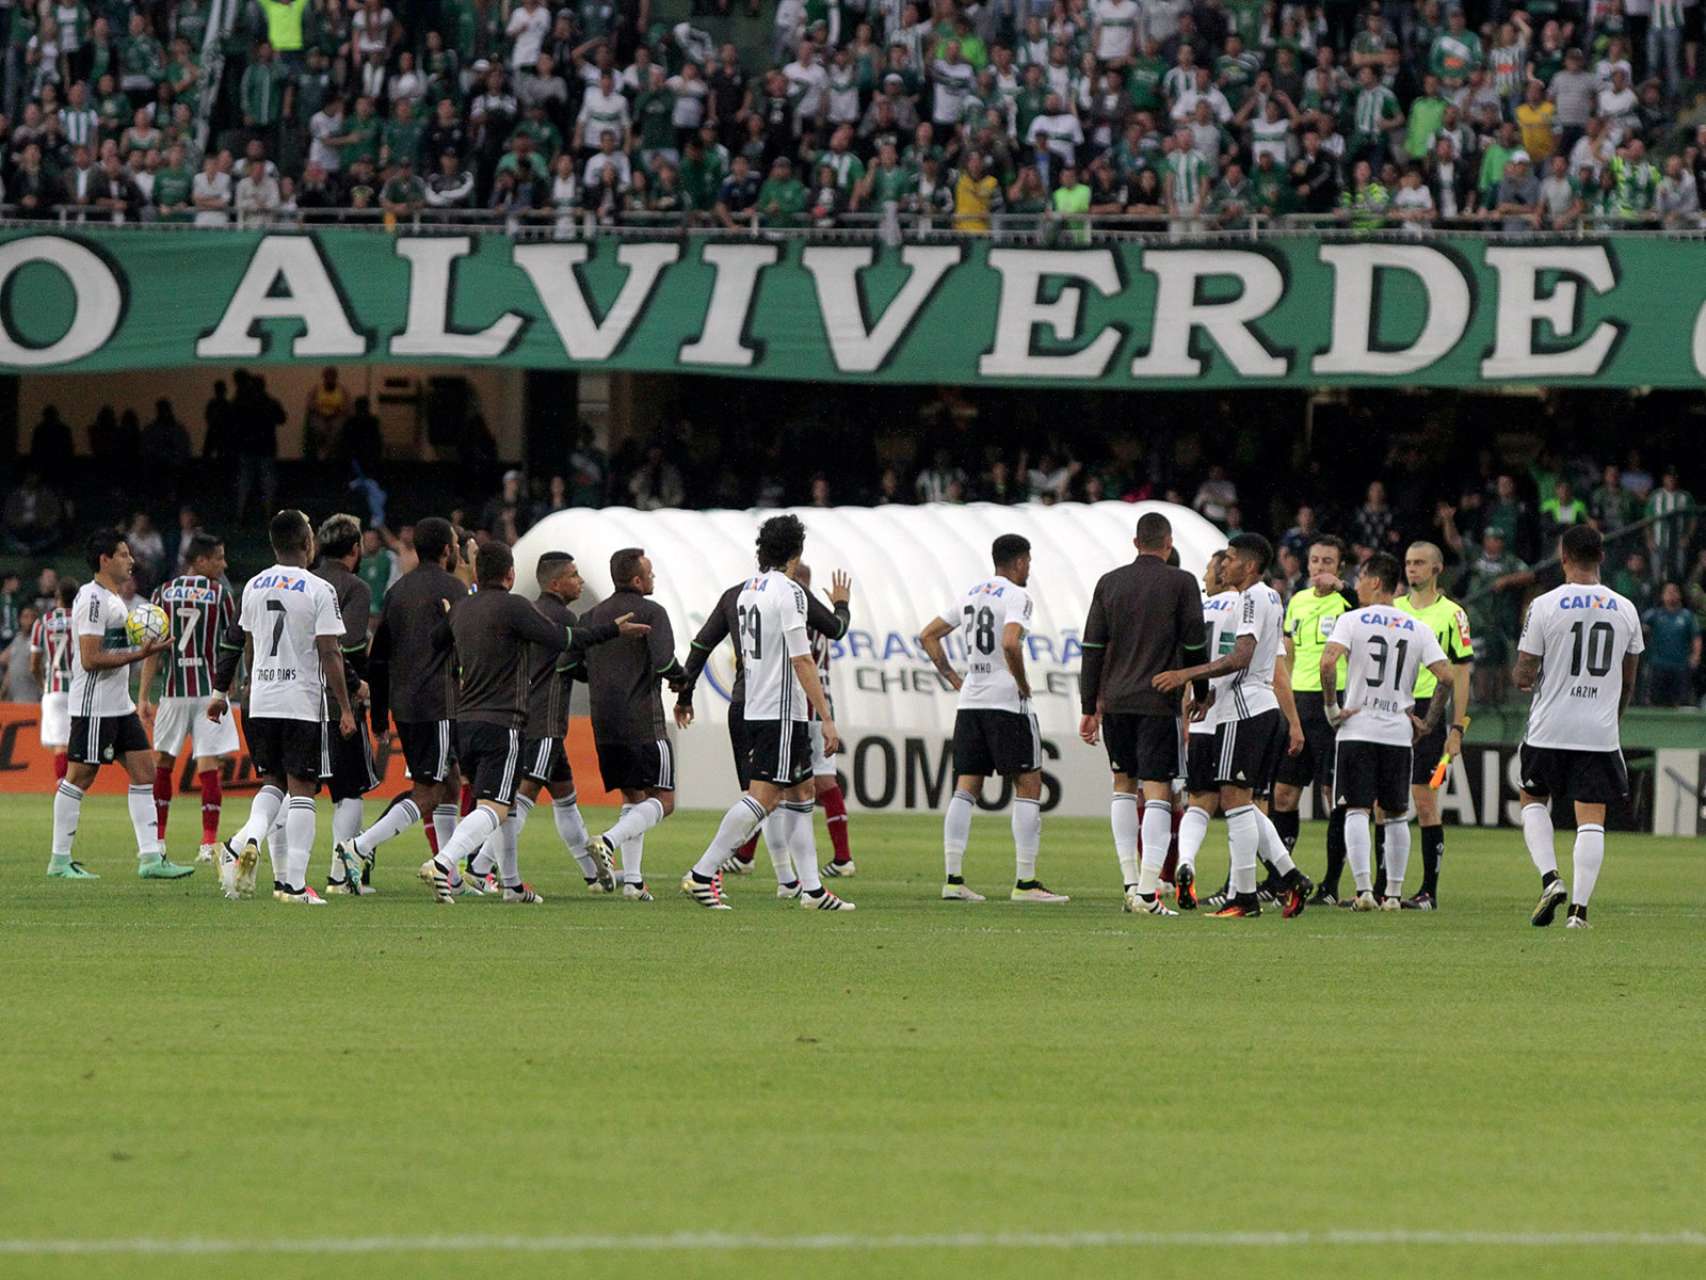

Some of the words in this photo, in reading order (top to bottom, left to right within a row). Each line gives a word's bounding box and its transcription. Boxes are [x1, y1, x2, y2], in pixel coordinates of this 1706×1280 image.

[196, 236, 1620, 378] ALVIVERDE
[163, 586, 216, 602] CAIXA
[253, 575, 306, 592] CAIXA
[1560, 595, 1618, 611] CAIXA
[176, 608, 201, 652] 7
[266, 600, 287, 656] 7
[964, 604, 995, 656] 28
[1360, 613, 1415, 631] CAIXA
[1366, 635, 1408, 691] 31
[1570, 621, 1615, 677] 10
[1570, 686, 1598, 698] KAZIM
